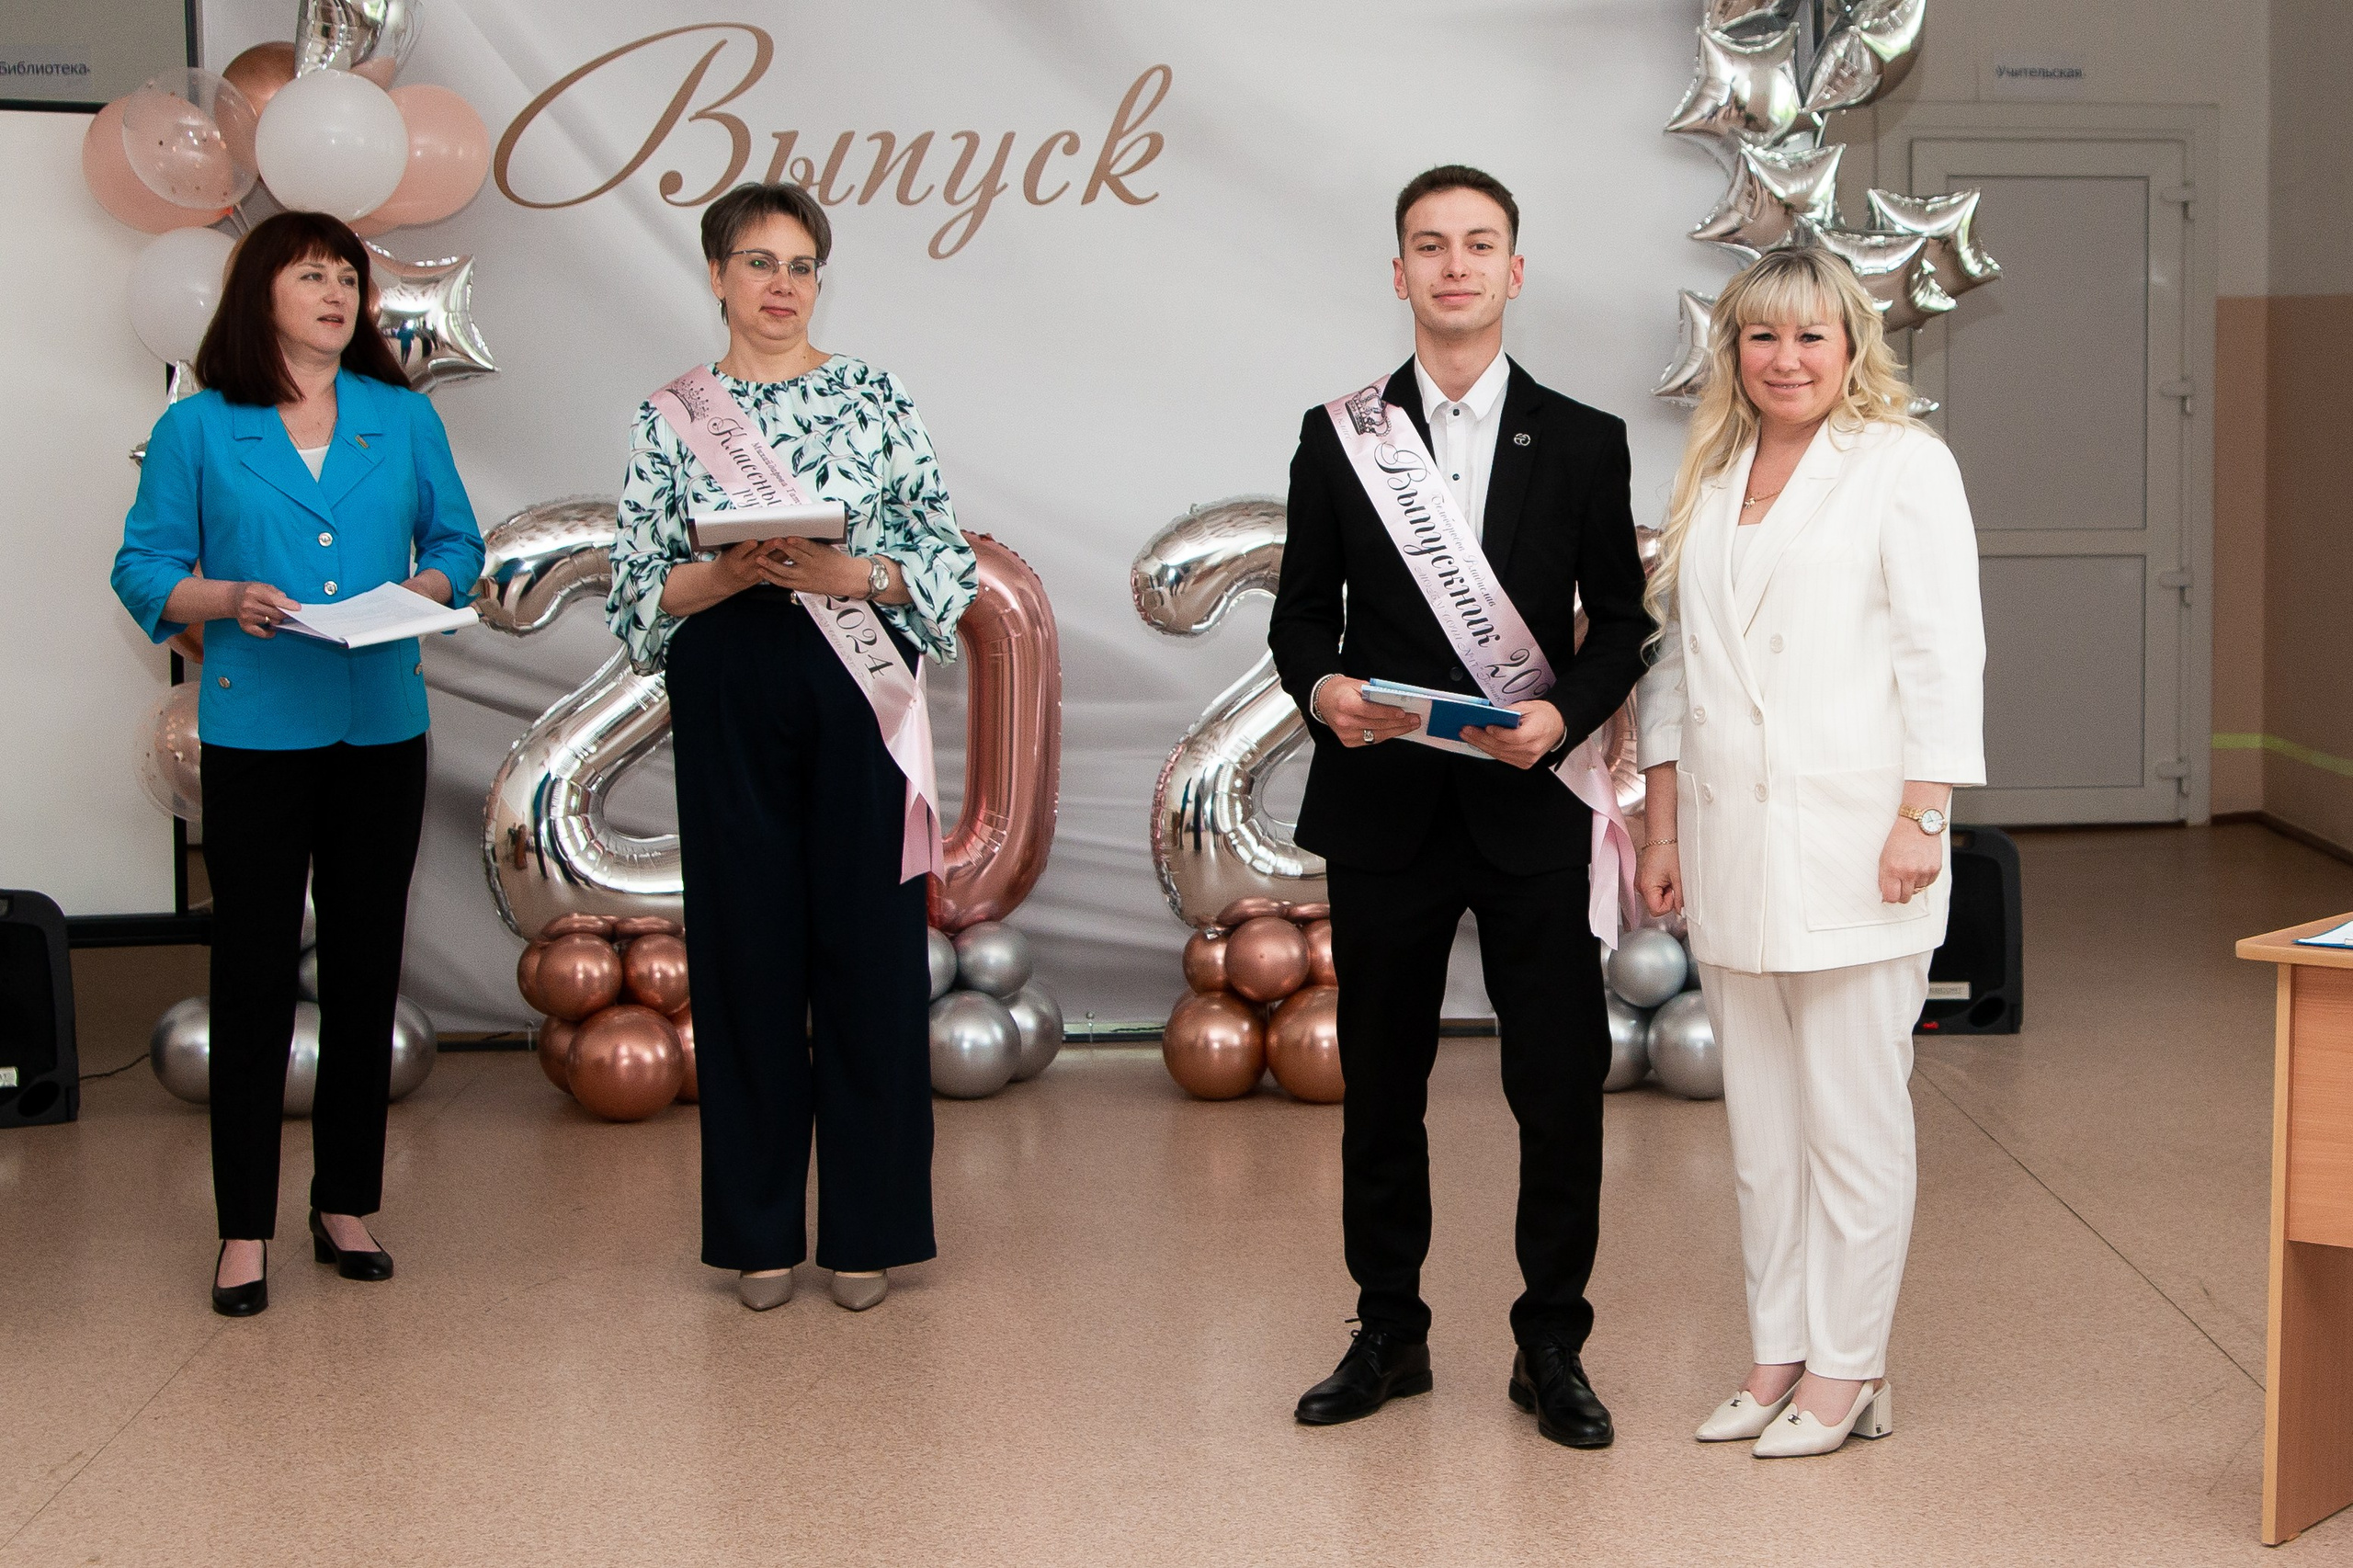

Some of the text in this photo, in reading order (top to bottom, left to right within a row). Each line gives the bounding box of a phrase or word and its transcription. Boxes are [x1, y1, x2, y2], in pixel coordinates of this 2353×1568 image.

[494, 22, 1173, 259] Выпуск
[1995, 65, 2083, 79] Учительская
[1374, 441, 1501, 648] Выпускник
